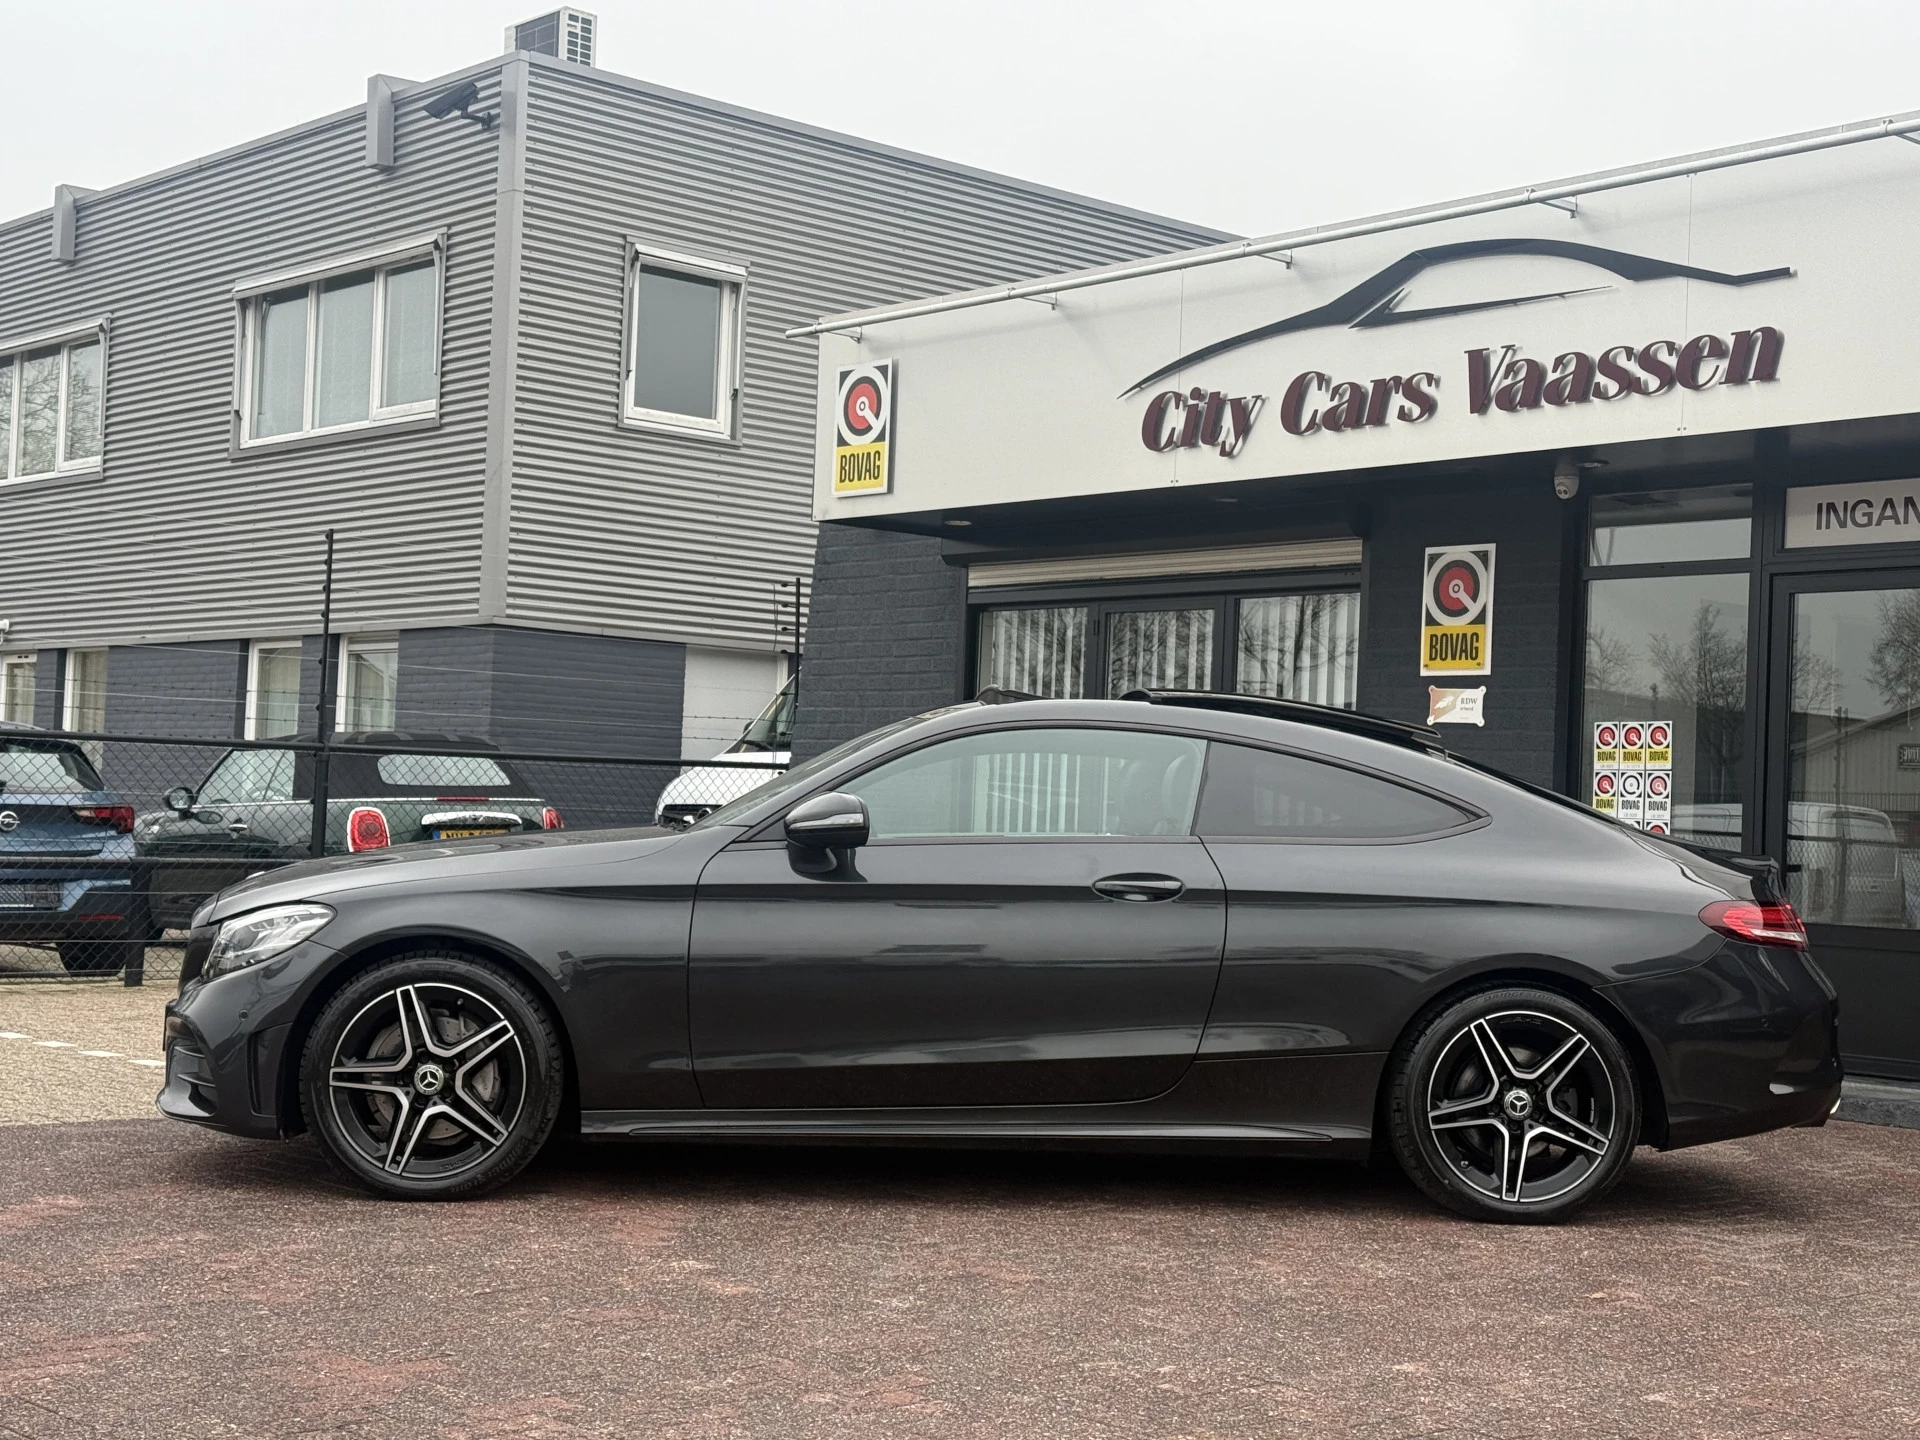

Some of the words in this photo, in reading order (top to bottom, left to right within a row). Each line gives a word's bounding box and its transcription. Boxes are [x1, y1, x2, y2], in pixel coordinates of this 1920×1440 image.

[1141, 386, 1263, 458] City
[1280, 370, 1436, 436] Cars
[1464, 326, 1778, 414] Vaassen
[839, 450, 881, 483] BOVAG
[1429, 632, 1480, 662] BOVAG
[1597, 751, 1616, 762] BOVAG
[1623, 751, 1642, 762] BOVAG
[1649, 750, 1668, 761] BOVAG
[1595, 799, 1614, 809] BOVAG
[1621, 799, 1640, 810] BOVAG
[1648, 800, 1668, 811] BOVAG
